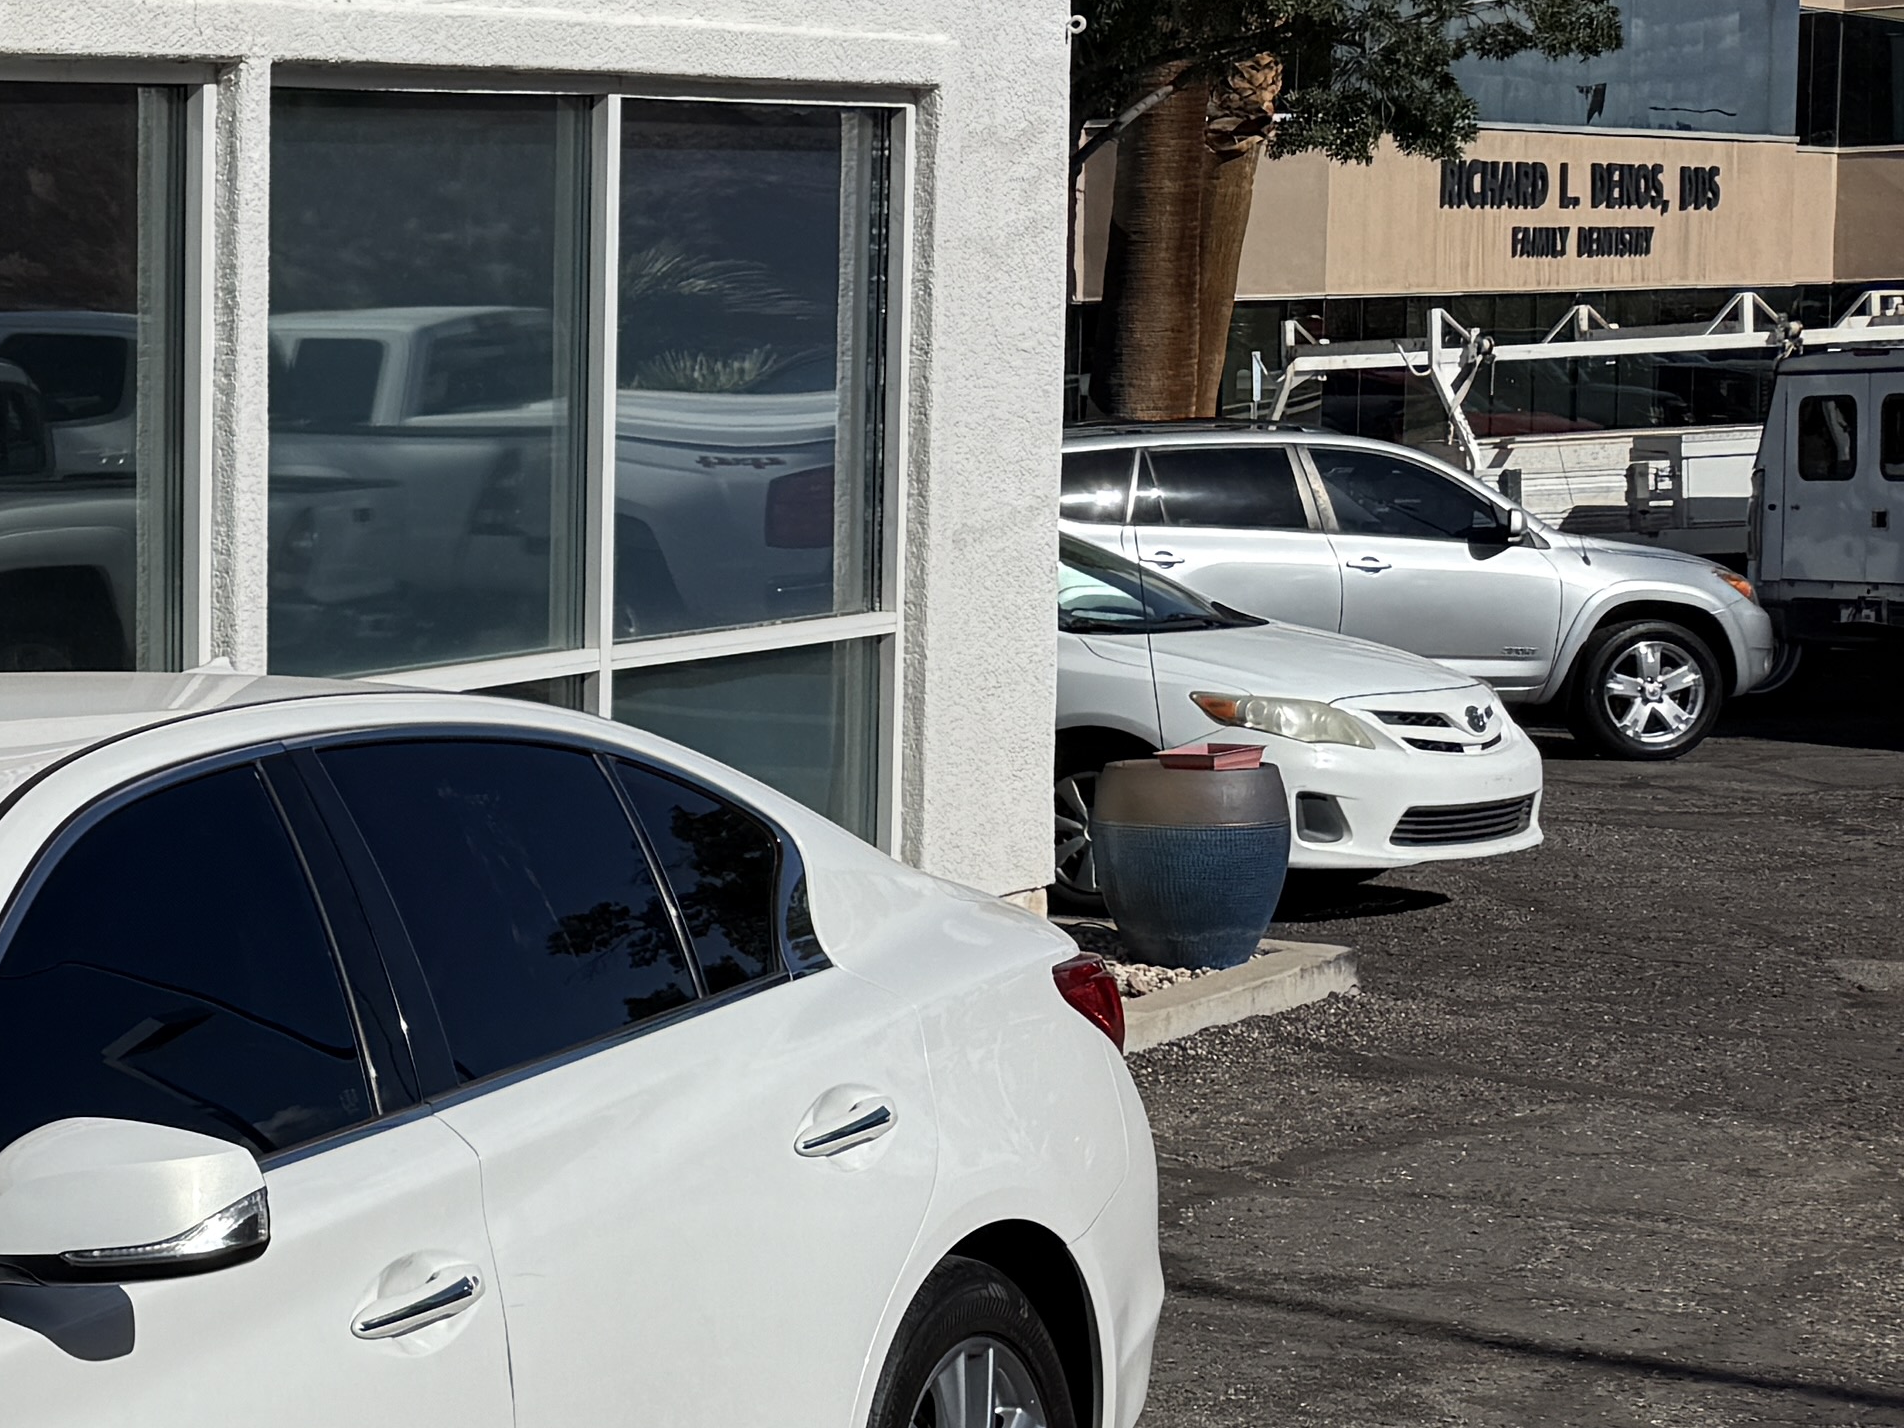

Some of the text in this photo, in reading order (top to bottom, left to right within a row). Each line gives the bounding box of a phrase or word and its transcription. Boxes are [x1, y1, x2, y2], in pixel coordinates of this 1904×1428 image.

[1439, 159, 1550, 210] RICHARD
[1559, 162, 1581, 210] L.
[1679, 165, 1721, 212] DDS
[1511, 226, 1656, 259] FAMILY DENTISTRY
